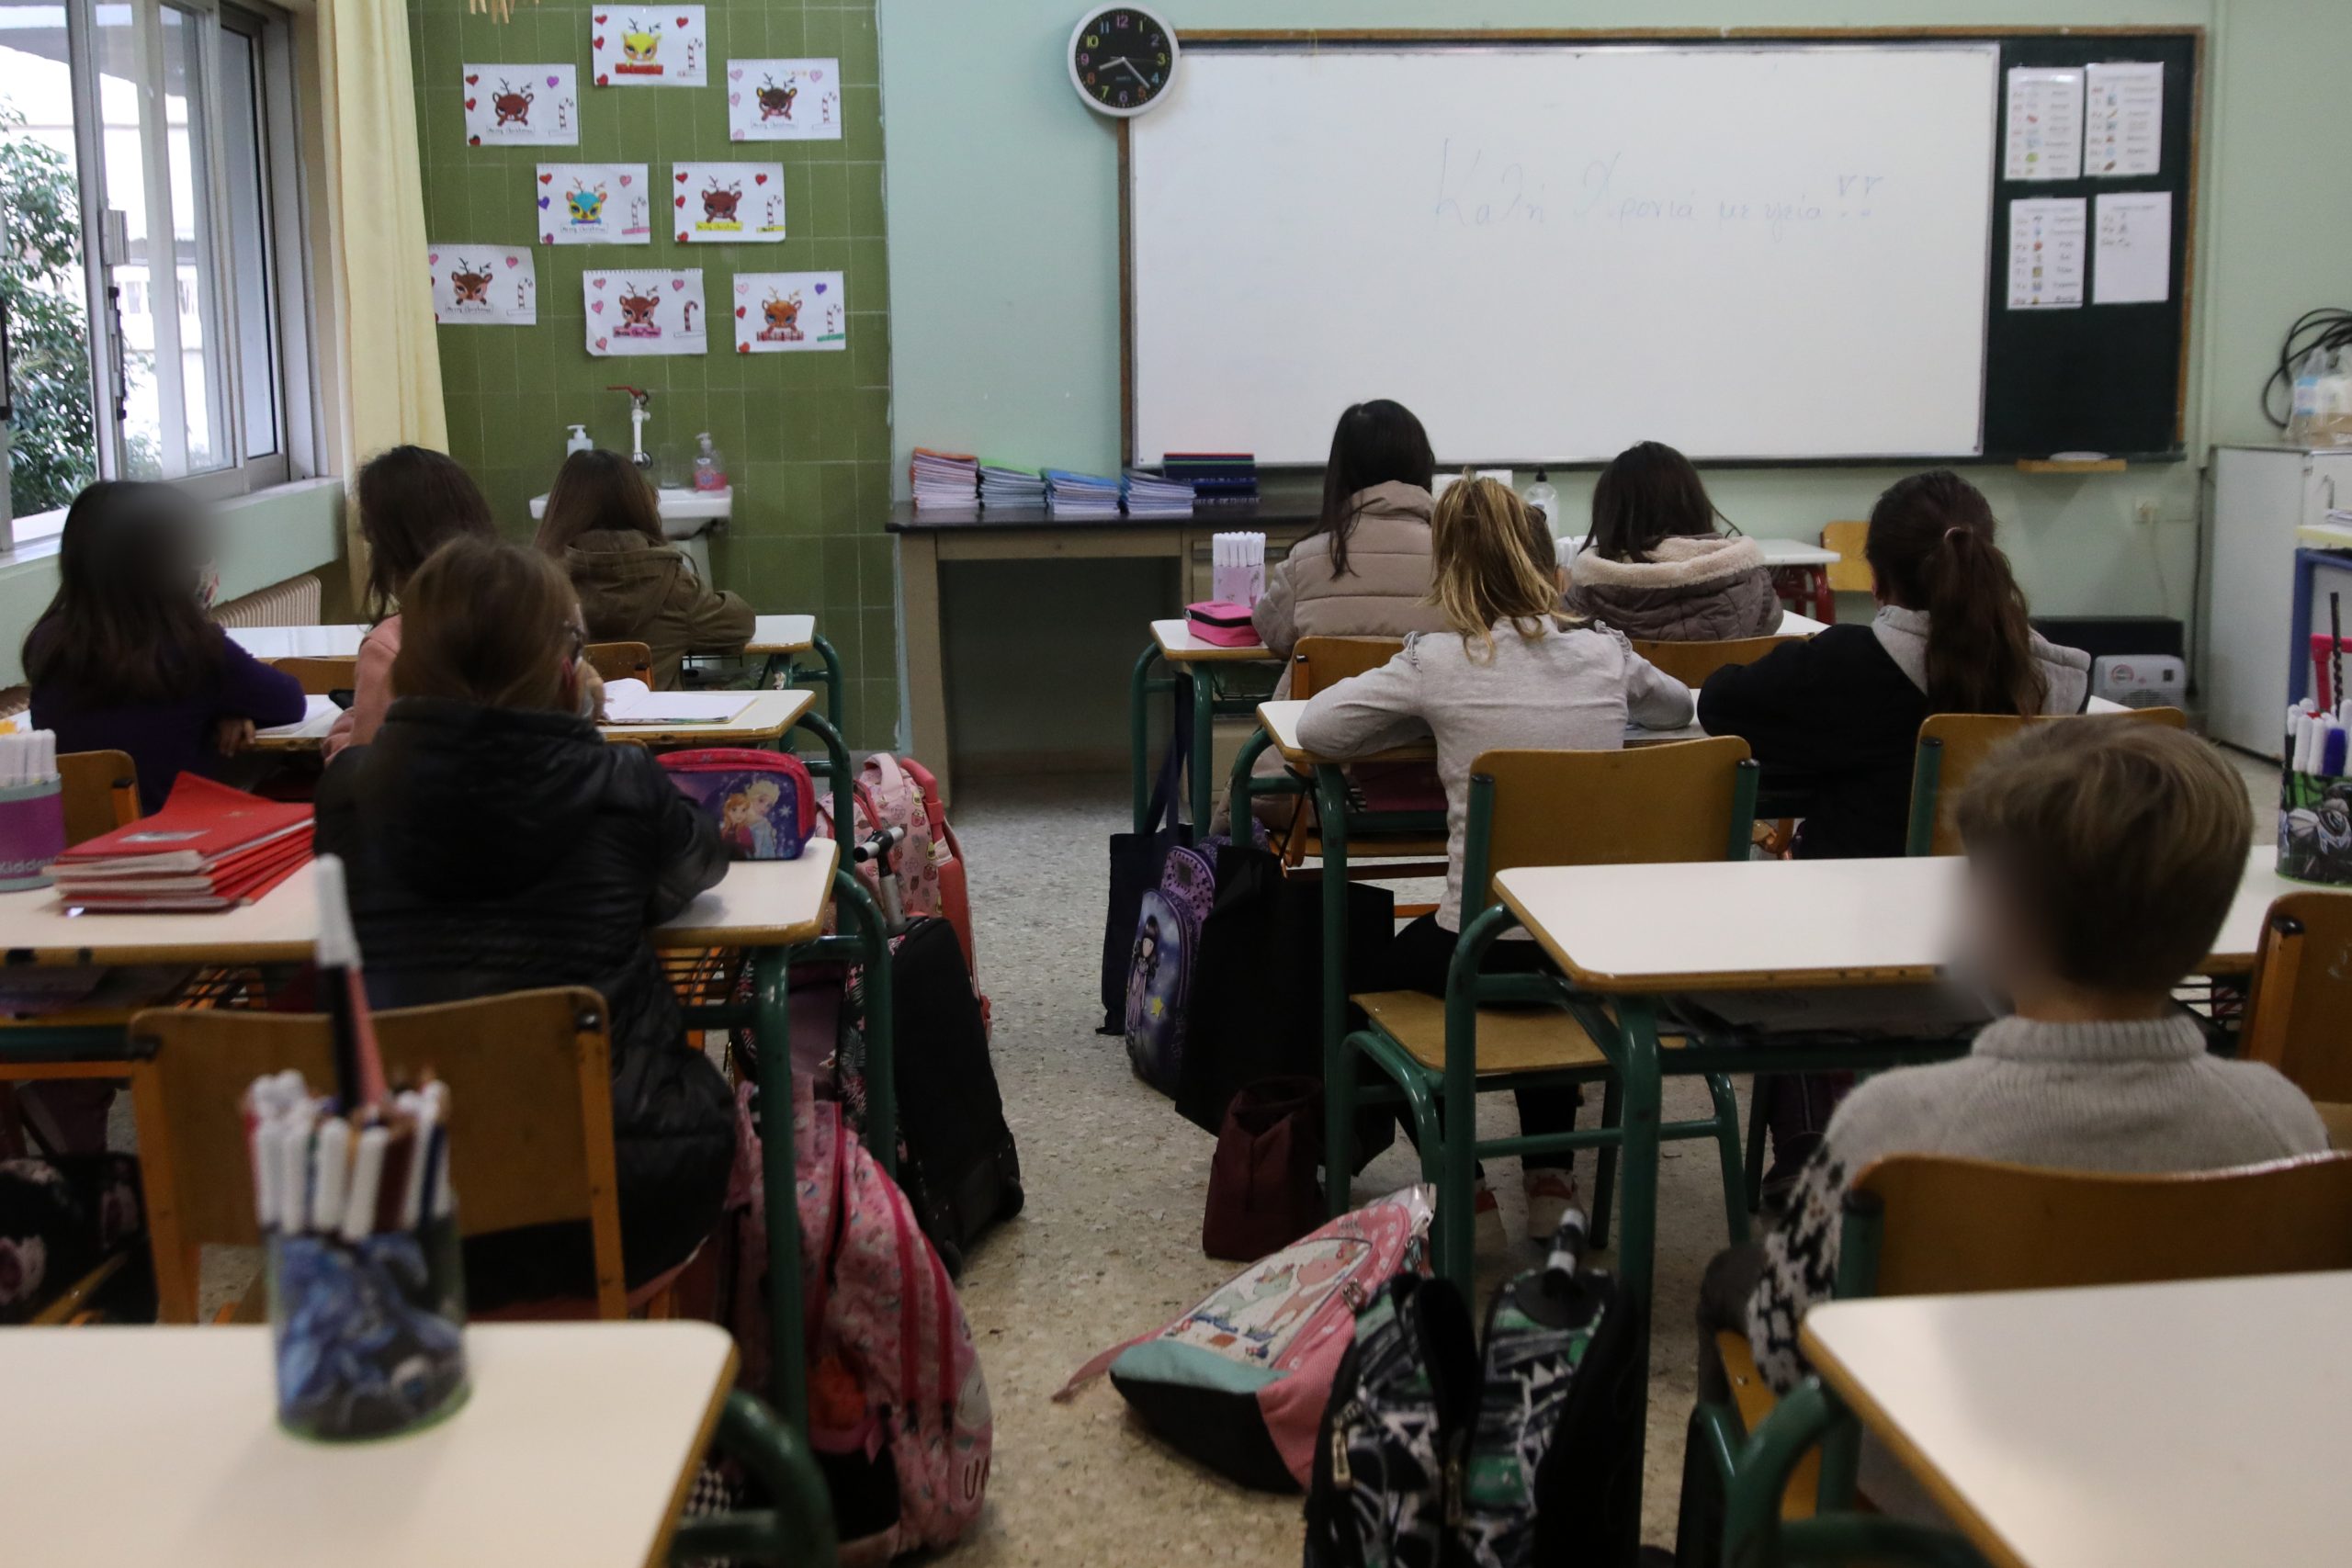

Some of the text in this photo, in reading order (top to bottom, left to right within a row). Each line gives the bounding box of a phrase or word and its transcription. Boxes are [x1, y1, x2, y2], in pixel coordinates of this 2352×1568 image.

[1101, 21, 1110, 34] 11
[1117, 15, 1129, 28] 12
[1139, 20, 1144, 32] 1
[1087, 35, 1099, 48] 10
[1151, 34, 1159, 47] 2
[1080, 53, 1090, 65] 9
[1157, 52, 1166, 66] 3
[1087, 73, 1095, 85] 8
[1151, 73, 1159, 84] 4
[1102, 85, 1110, 98] 7
[1119, 90, 1128, 103] 6
